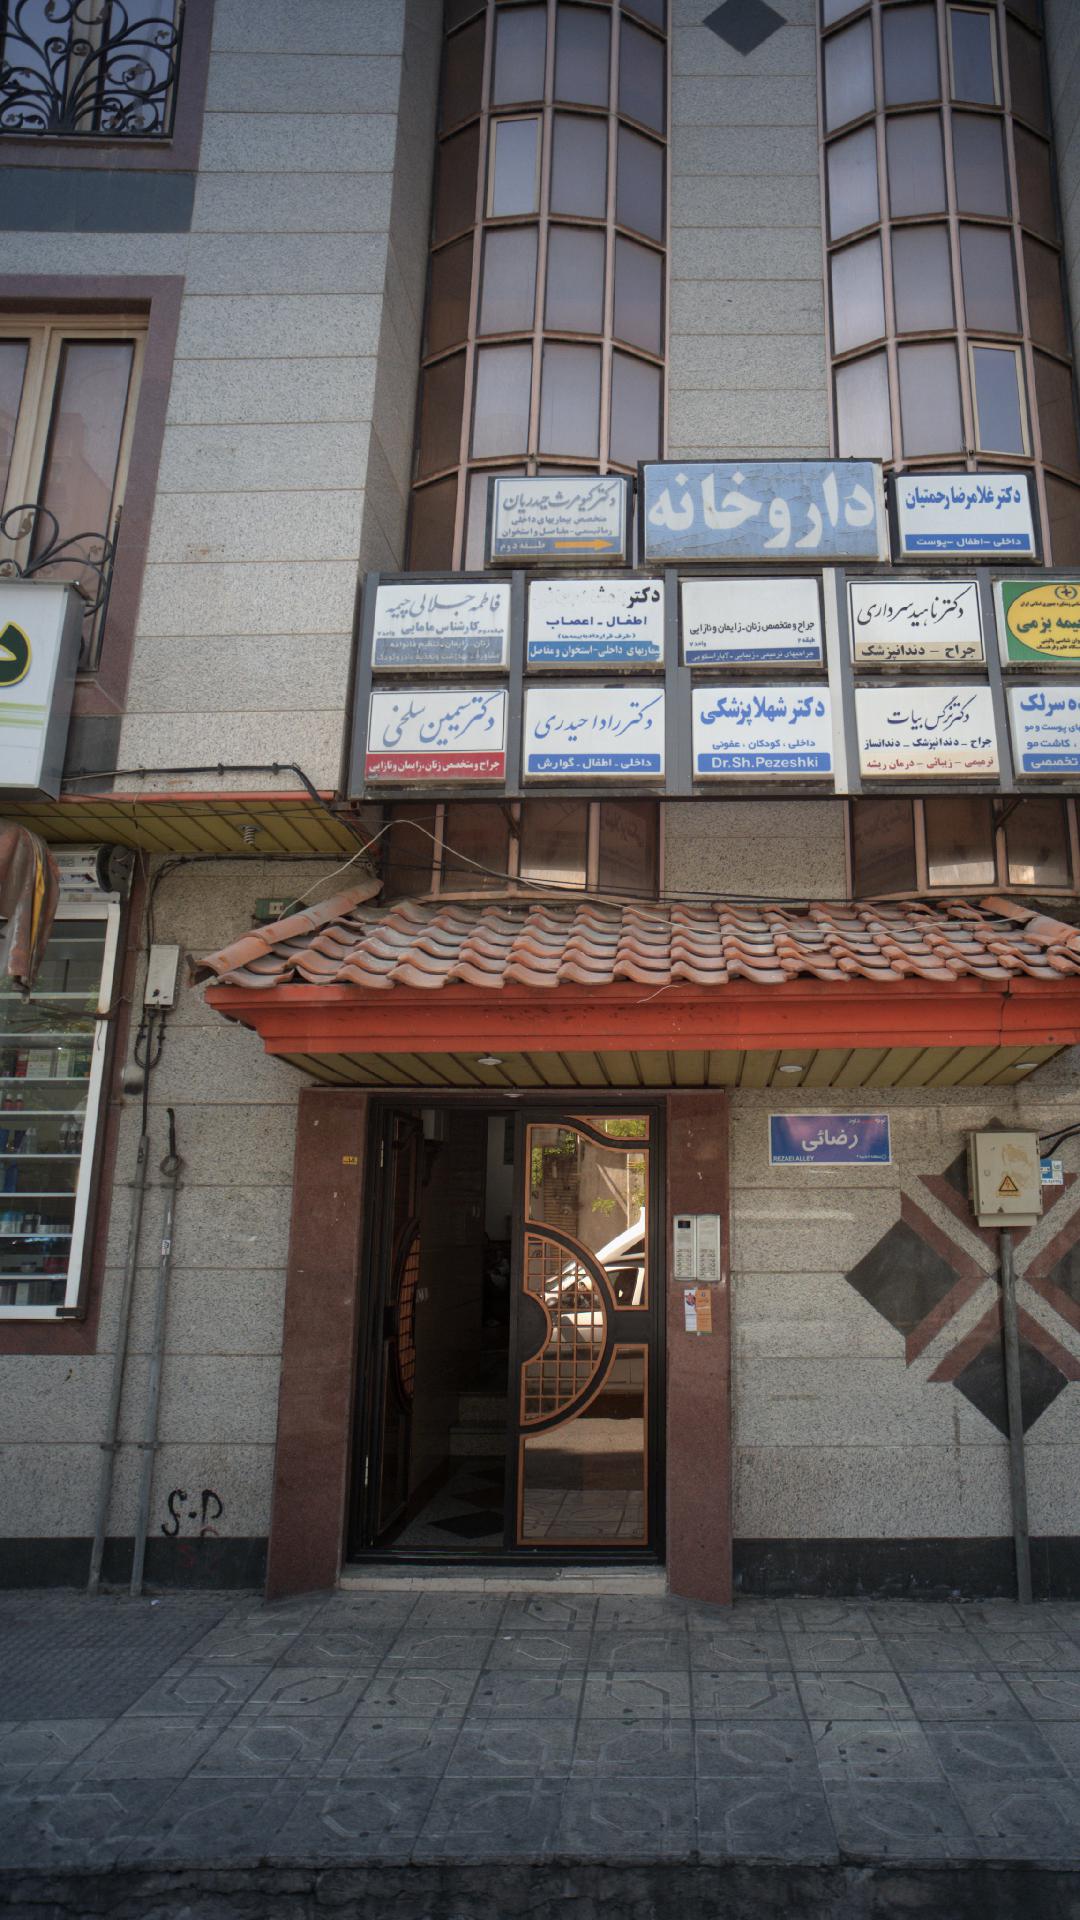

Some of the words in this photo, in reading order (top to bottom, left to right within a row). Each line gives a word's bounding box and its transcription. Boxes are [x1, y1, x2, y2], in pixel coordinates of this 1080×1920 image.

[503, 493, 550, 513] حیدریان
[548, 482, 603, 512] کیومرث
[588, 482, 619, 511] دکتر
[905, 486, 950, 509] رحمتیان
[951, 485, 994, 509] غلامرضا
[995, 486, 1021, 509] دکتر
[648, 471, 874, 548] داروخانه
[511, 515, 536, 525] داخلی
[573, 515, 607, 525] متخصص
[540, 527, 569, 538] مفاصل
[500, 543, 518, 552] دوم
[518, 540, 545, 549] طبقه
[993, 537, 1021, 547] داخلی
[469, 592, 501, 613] فاطمه
[626, 586, 660, 608] دکتر
[408, 593, 475, 617] جلالی
[934, 585, 973, 624] دکتر
[857, 602, 914, 625] سرداری
[907, 596, 939, 627] ناهید
[546, 616, 594, 629] اعصاب
[606, 614, 647, 627] اطفال
[761, 621, 791, 632] متخصص
[798, 620, 815, 633] جراح
[1017, 616, 1052, 633] بزمی
[401, 621, 434, 635] مامایی
[436, 620, 480, 635] کارشناس
[689, 623, 712, 635] نازایی
[718, 622, 742, 633] زایمان
[746, 622, 761, 633] زنان
[530, 645, 554, 658] مفاصل
[561, 644, 593, 658] استخوان
[598, 644, 623, 657] داخلی
[862, 644, 926, 660] دندانپزشک
[945, 645, 975, 659] جراح
[753, 696, 788, 722] شهلا
[788, 696, 826, 724] دکتر
[1020, 692, 1066, 716] سرلک
[454, 690, 503, 740] دکتر
[615, 695, 663, 737] دکتر
[700, 697, 753, 726] پزشکی
[925, 695, 959, 730] نرگس
[943, 694, 977, 731] دکتر
[420, 702, 471, 745] سیمین
[887, 709, 924, 730] بیات
[534, 715, 588, 741] حیدری
[1041, 724, 1066, 733] پوست
[712, 740, 740, 750] عفونی
[748, 739, 780, 750] کودکان
[788, 739, 816, 750] داخلی
[864, 738, 901, 750] دندانساز
[912, 738, 960, 750] دندانپزشک
[970, 737, 992, 749] جراح
[1026, 741, 1039, 750] مو
[1040, 738, 1071, 748] کاشت
[442, 760, 472, 772] متخصص
[480, 760, 500, 772] جراح
[537, 756, 575, 770] گوارش
[582, 758, 612, 769] اطفال
[621, 758, 652, 769] داخلی
[711, 756, 819, 769] Dr.Sh.Pezeshki
[866, 759, 888, 771] ریشه
[889, 758, 915, 770] درمان
[964, 757, 994, 768] ترمیمی
[1031, 756, 1079, 769] تخصصی
[801, 1129, 858, 1151] رضائی
